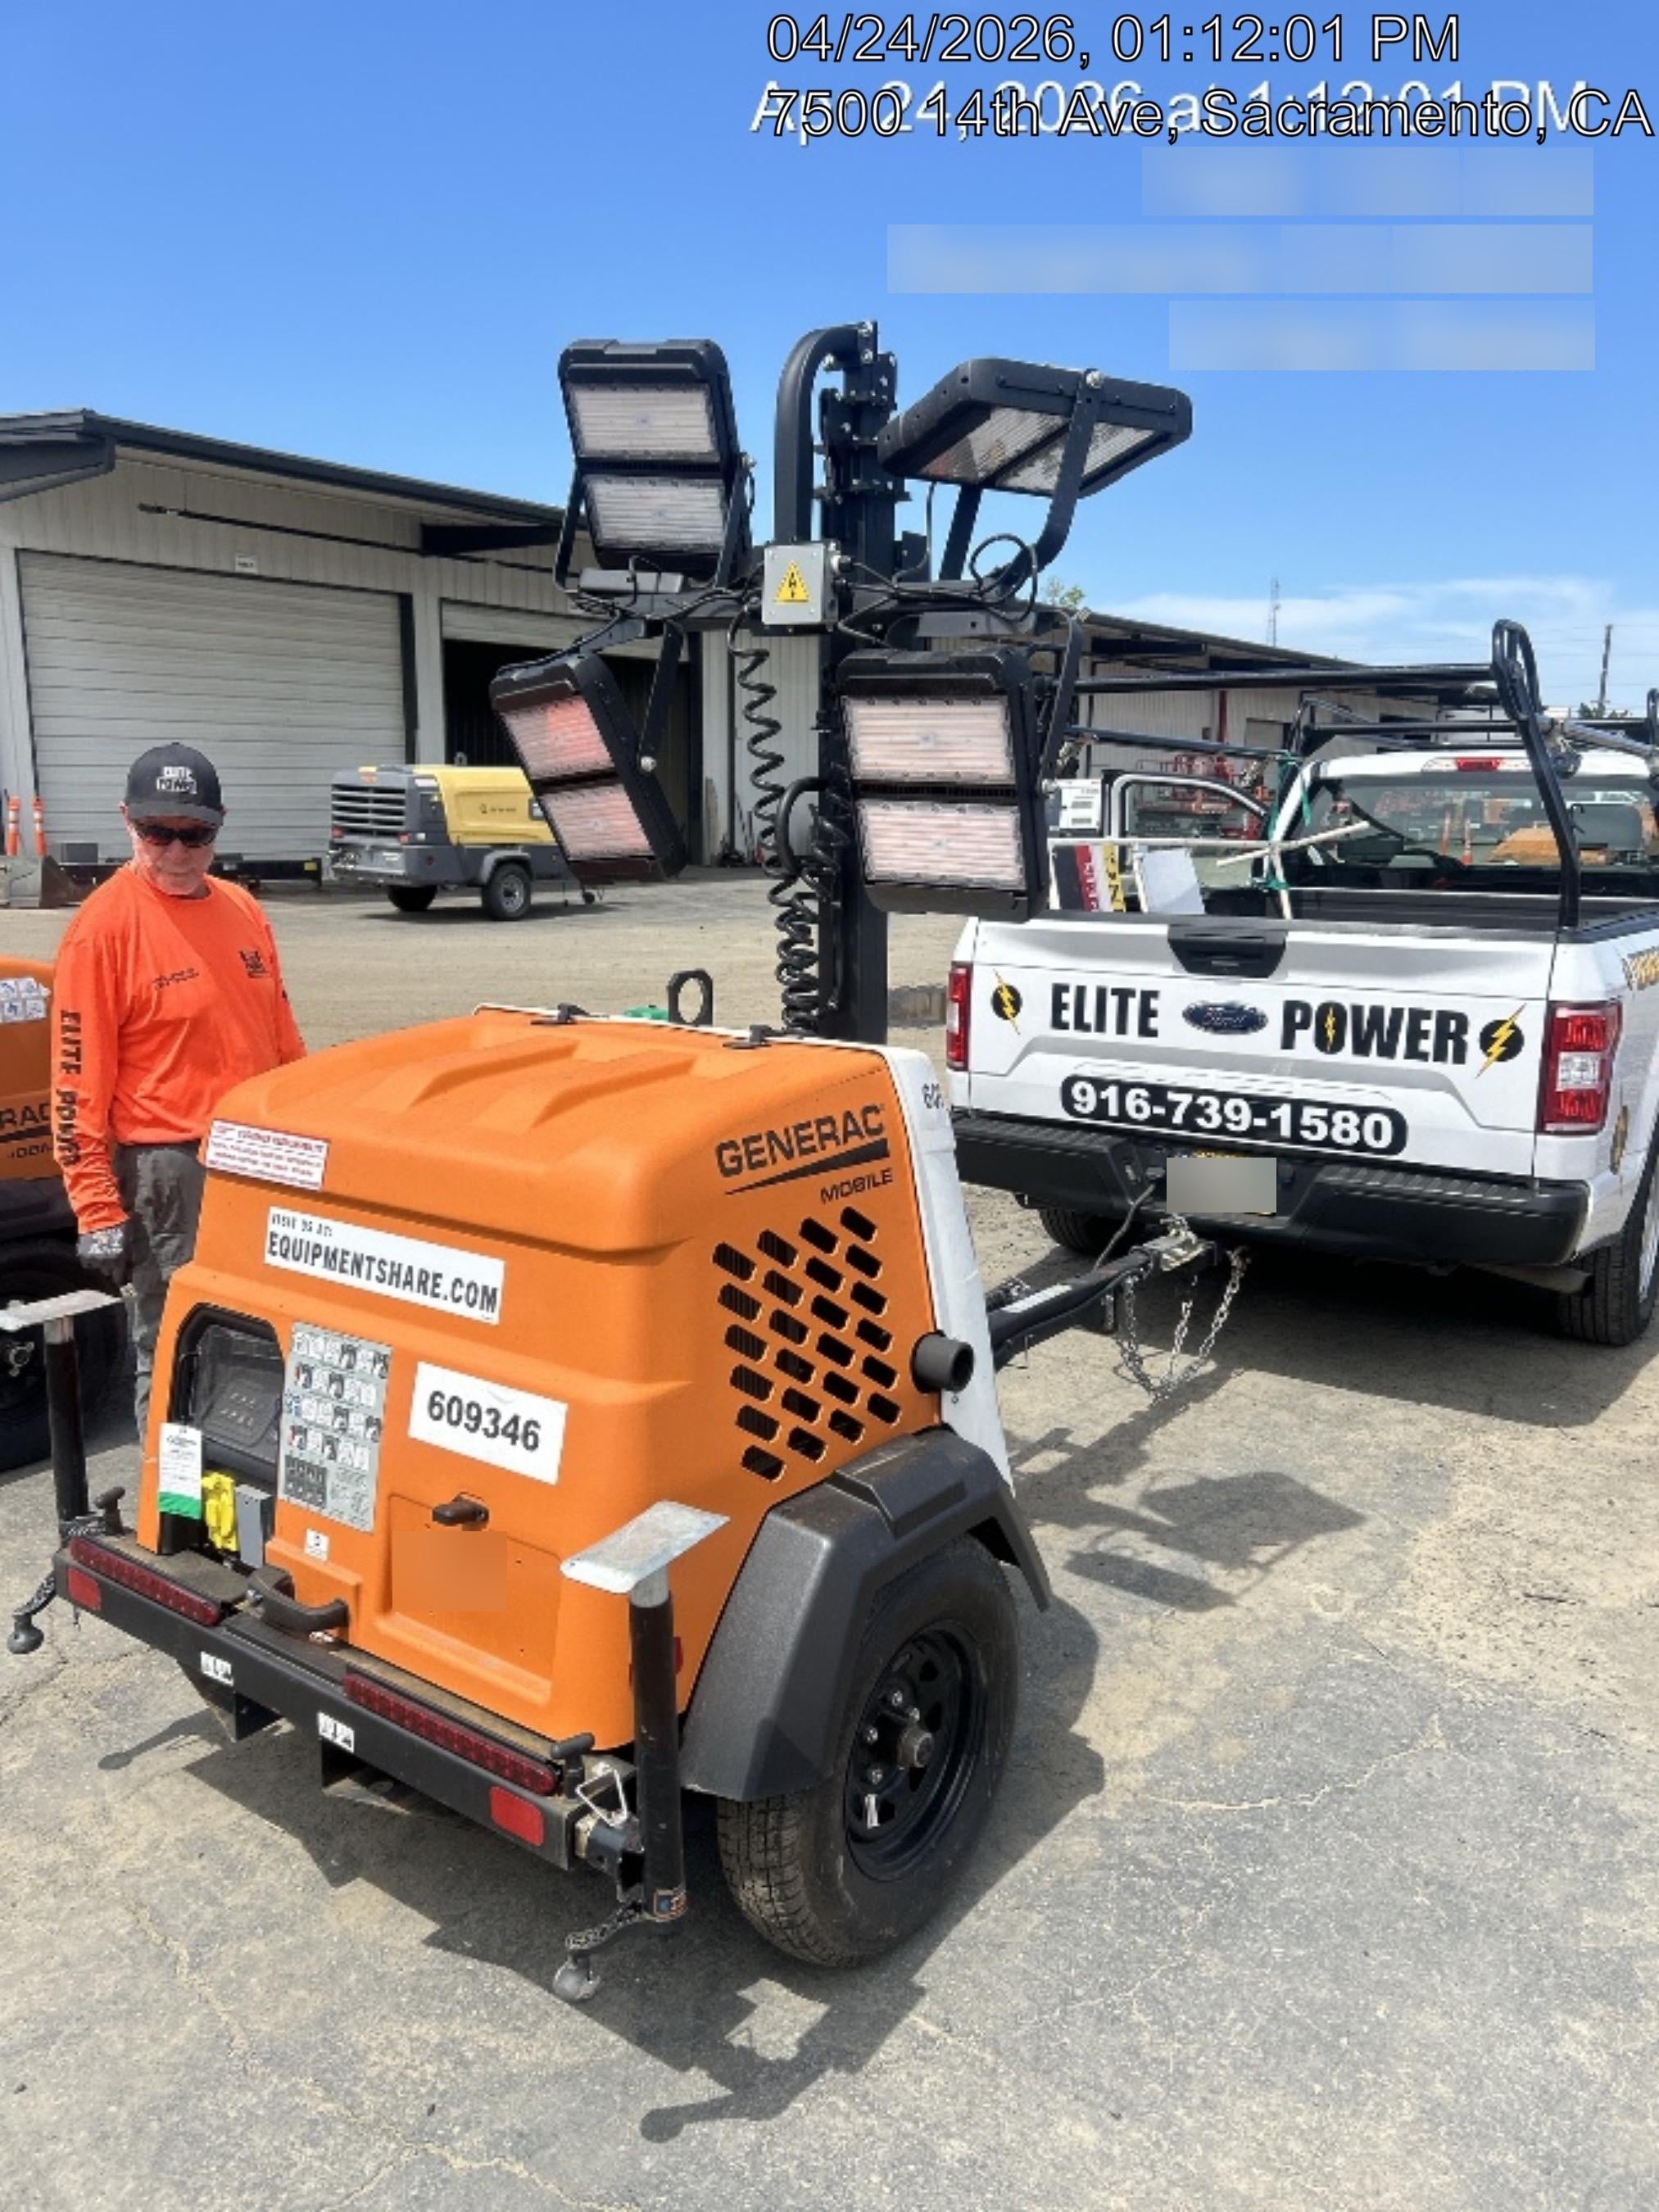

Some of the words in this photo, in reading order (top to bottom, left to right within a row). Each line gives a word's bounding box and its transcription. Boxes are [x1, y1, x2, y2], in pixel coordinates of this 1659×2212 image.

[61, 1009, 82, 1075] ELITE
[1050, 982, 1161, 1038] ELITE
[1280, 999, 1470, 1065] POWER
[715, 1105, 884, 1178] GENERAC
[1070, 1081, 1393, 1149] 916-739-1580
[820, 1168, 893, 1204] MOBILE
[267, 1230, 499, 1314] EQUIPMENTSHARE.COM
[427, 1389, 541, 1453] 609346
